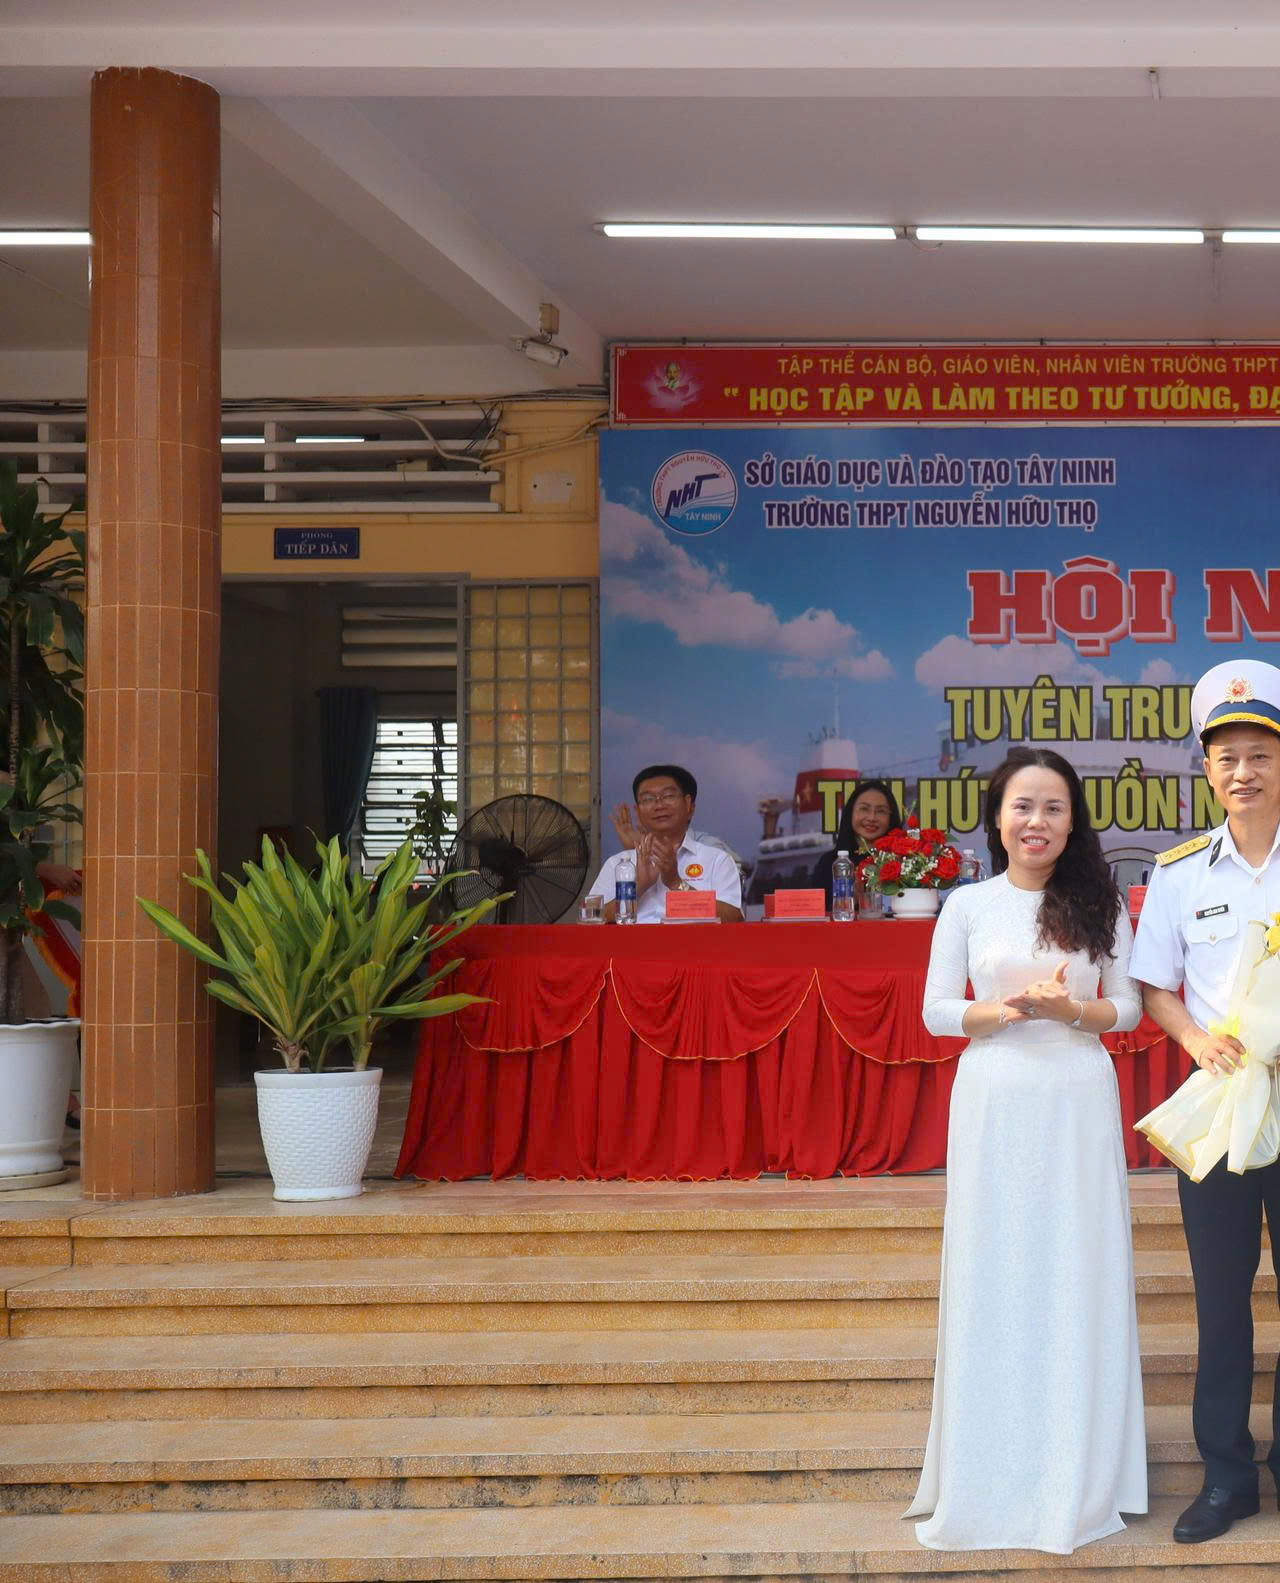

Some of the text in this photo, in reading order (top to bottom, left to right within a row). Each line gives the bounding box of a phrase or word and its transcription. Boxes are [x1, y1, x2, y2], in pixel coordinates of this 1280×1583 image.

[778, 355, 812, 377] TẬP
[819, 351, 854, 374] THỂ
[861, 355, 900, 374] CÁN
[906, 355, 937, 377] BỘ,
[943, 355, 988, 374] GIÁO
[994, 355, 1040, 376] VIÊN,
[1046, 354, 1096, 373] NHÂN
[1103, 354, 1145, 373] VIÊN
[1151, 354, 1227, 373] TRƯỜNG
[1232, 357, 1279, 373] THPT
[749, 387, 809, 414] HỌC
[819, 384, 874, 415] TẬP
[884, 384, 922, 410] VÀ
[931, 383, 995, 410] LÀM
[1004, 386, 1079, 410] THEO
[1088, 385, 1127, 409] TƯ
[1134, 380, 1240, 412] TƯỞNG,
[745, 452, 1116, 491] SỞ GIÁO DỤC VÀ ĐÀO TẠO TÂY NINH
[664, 473, 720, 519] NHT
[764, 491, 1098, 531] TRƯỜNG THPT NGUYỄN HỮU THỌ
[966, 554, 1177, 656] HỘI
[945, 675, 1095, 742] TUYÊN
